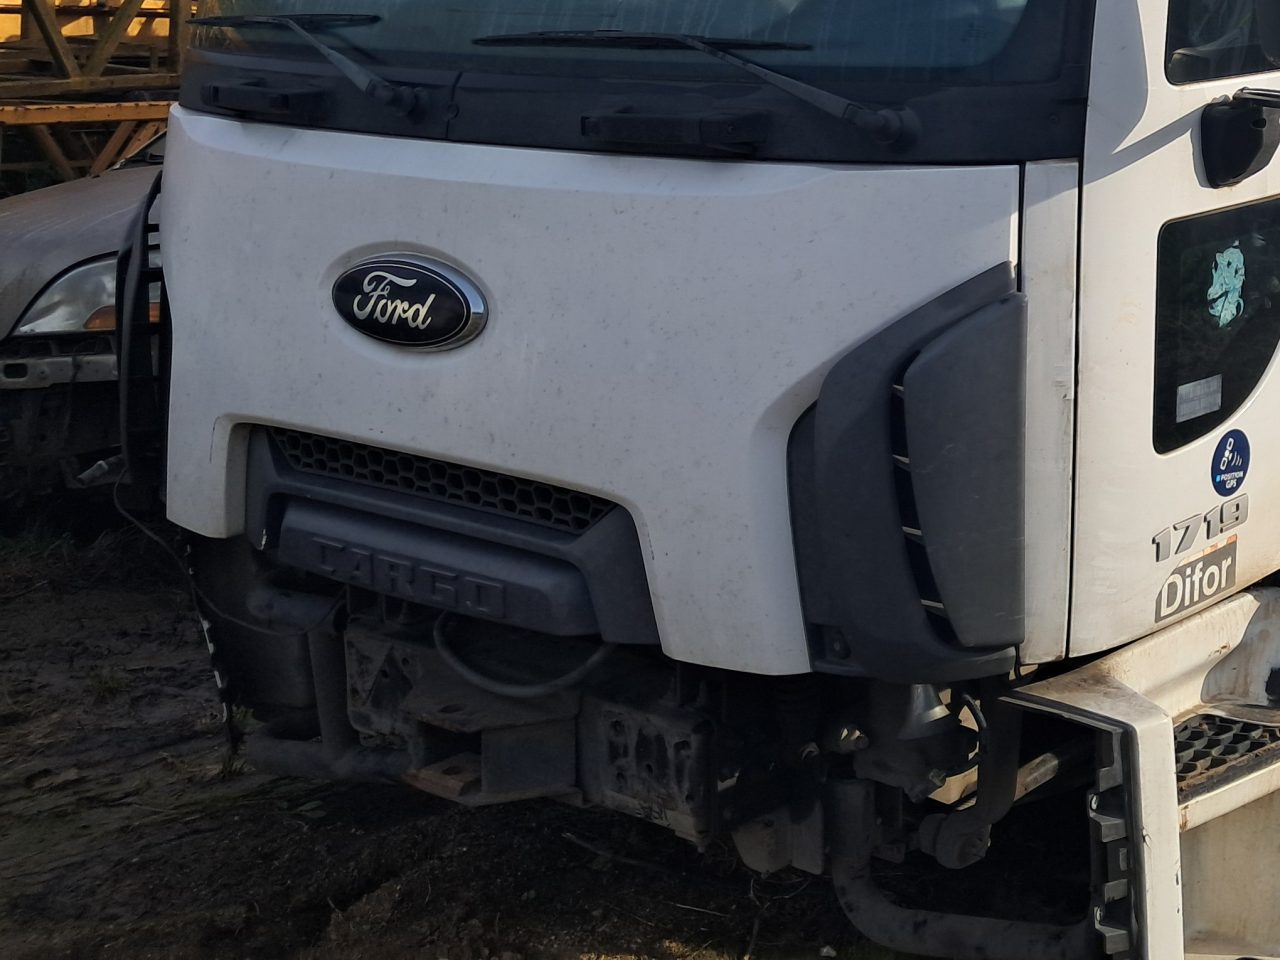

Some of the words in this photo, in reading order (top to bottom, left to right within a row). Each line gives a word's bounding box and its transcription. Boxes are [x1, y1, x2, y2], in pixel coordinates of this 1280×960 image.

[353, 271, 436, 330] Ford
[1220, 471, 1244, 482] POSITION
[1226, 479, 1237, 489] GPS
[1152, 492, 1249, 562] 1719
[312, 536, 506, 620] CARGO
[1160, 556, 1232, 617] Difor
